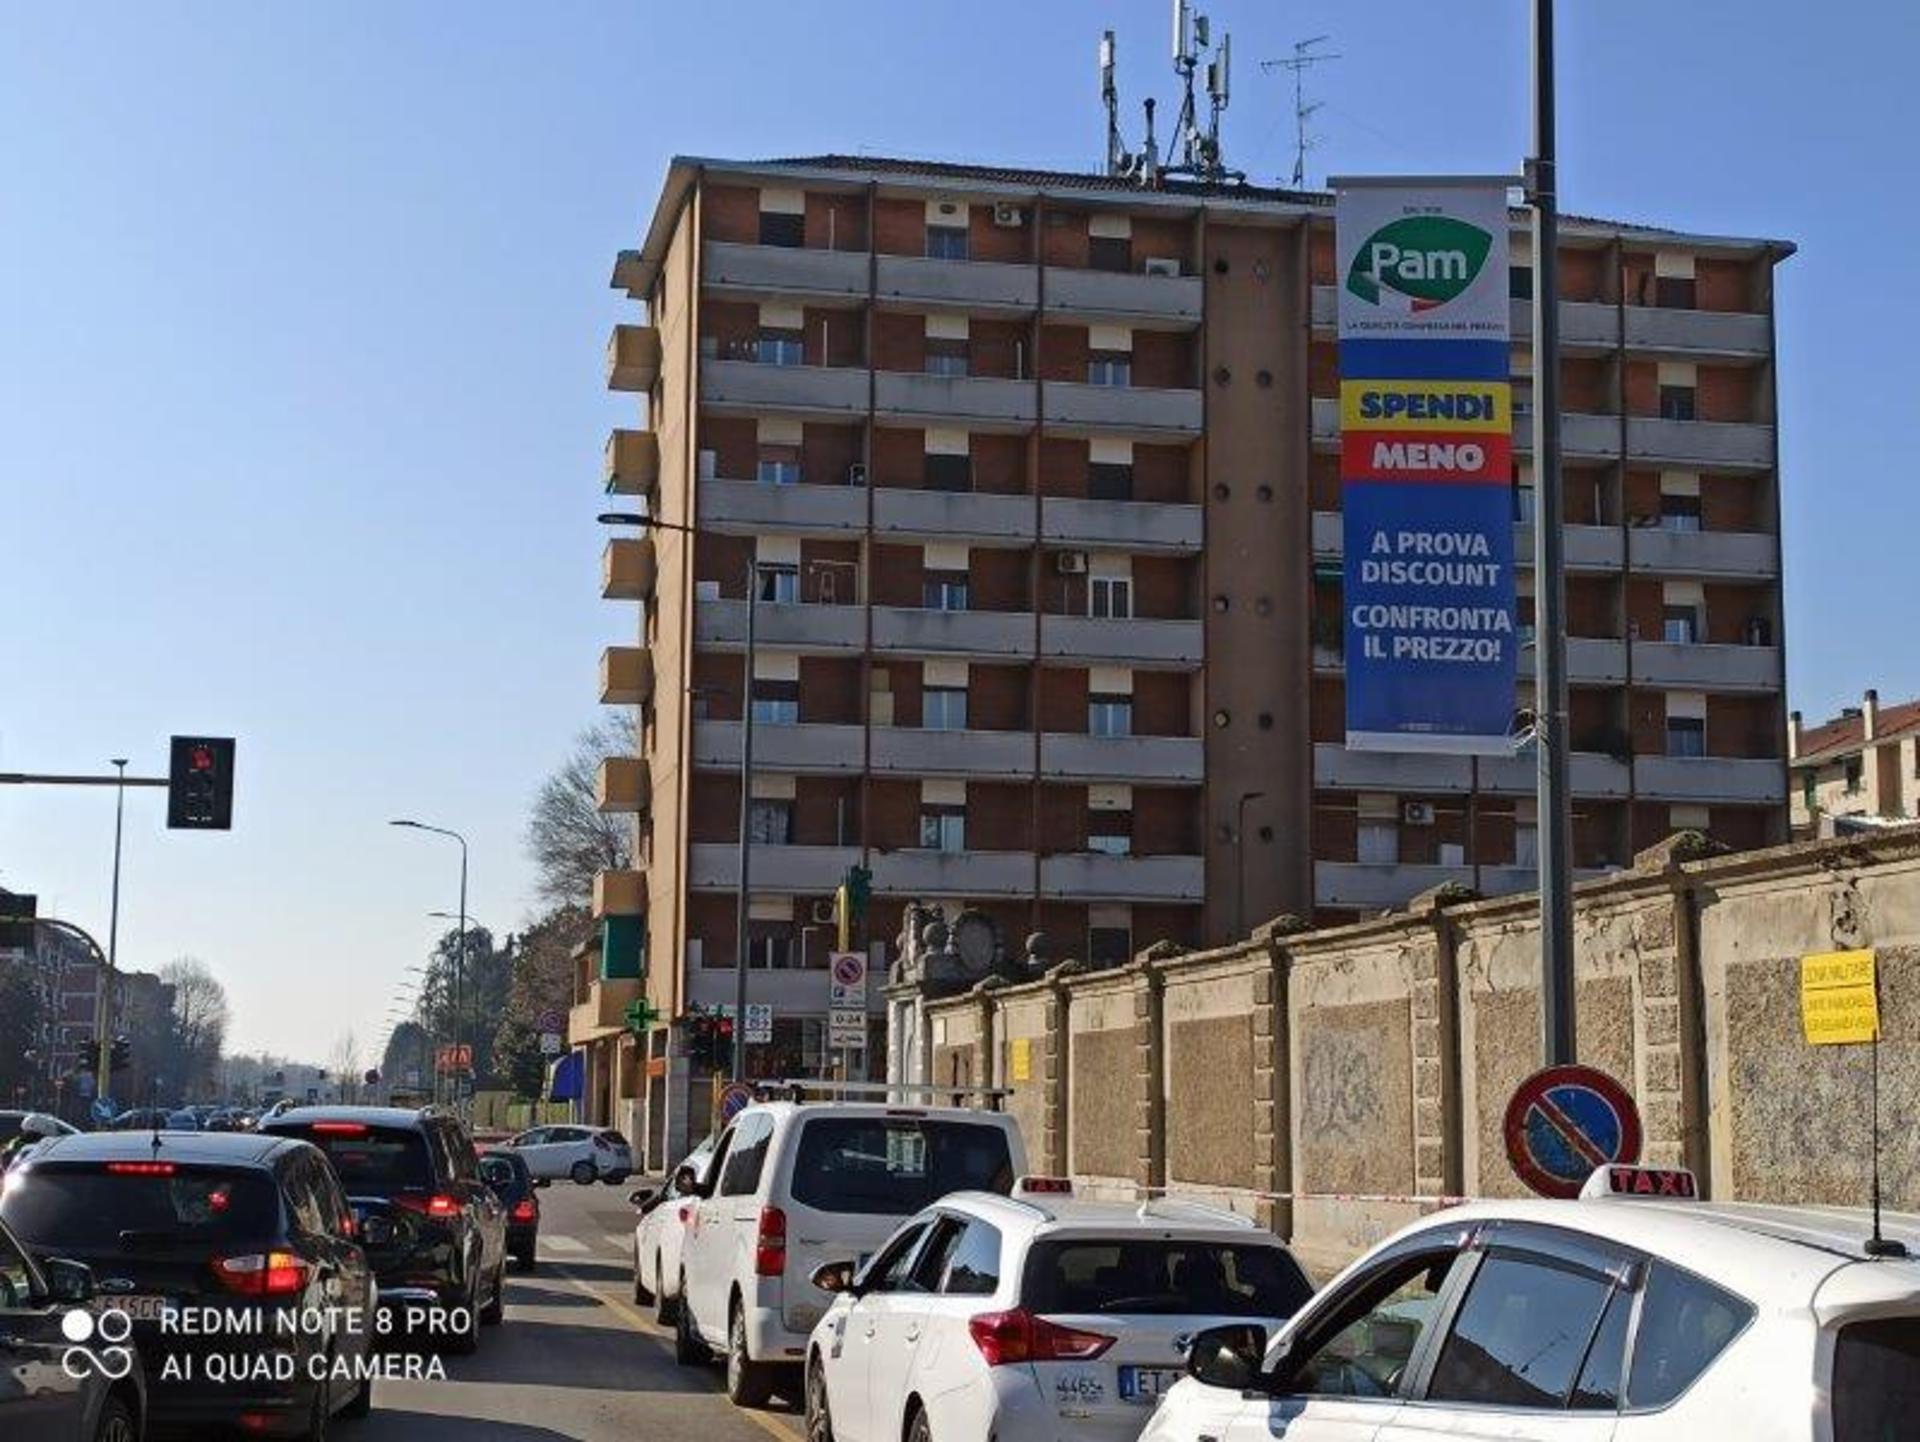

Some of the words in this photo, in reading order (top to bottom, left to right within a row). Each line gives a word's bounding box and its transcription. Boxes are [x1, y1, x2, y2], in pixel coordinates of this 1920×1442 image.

[1371, 242, 1467, 281] Pam
[1360, 391, 1494, 420] SPENDI
[1372, 441, 1485, 472] MENO
[1371, 531, 1391, 553] A
[1398, 532, 1489, 556] PROVA
[1362, 561, 1500, 586] DISCOUNT
[1352, 605, 1512, 633] CONFRONTA
[1364, 635, 1387, 658] IL
[1393, 636, 1501, 662] PREZZO!
[1024, 1178, 1069, 1192] TAXI
[1612, 1168, 1691, 1196] TAXI
